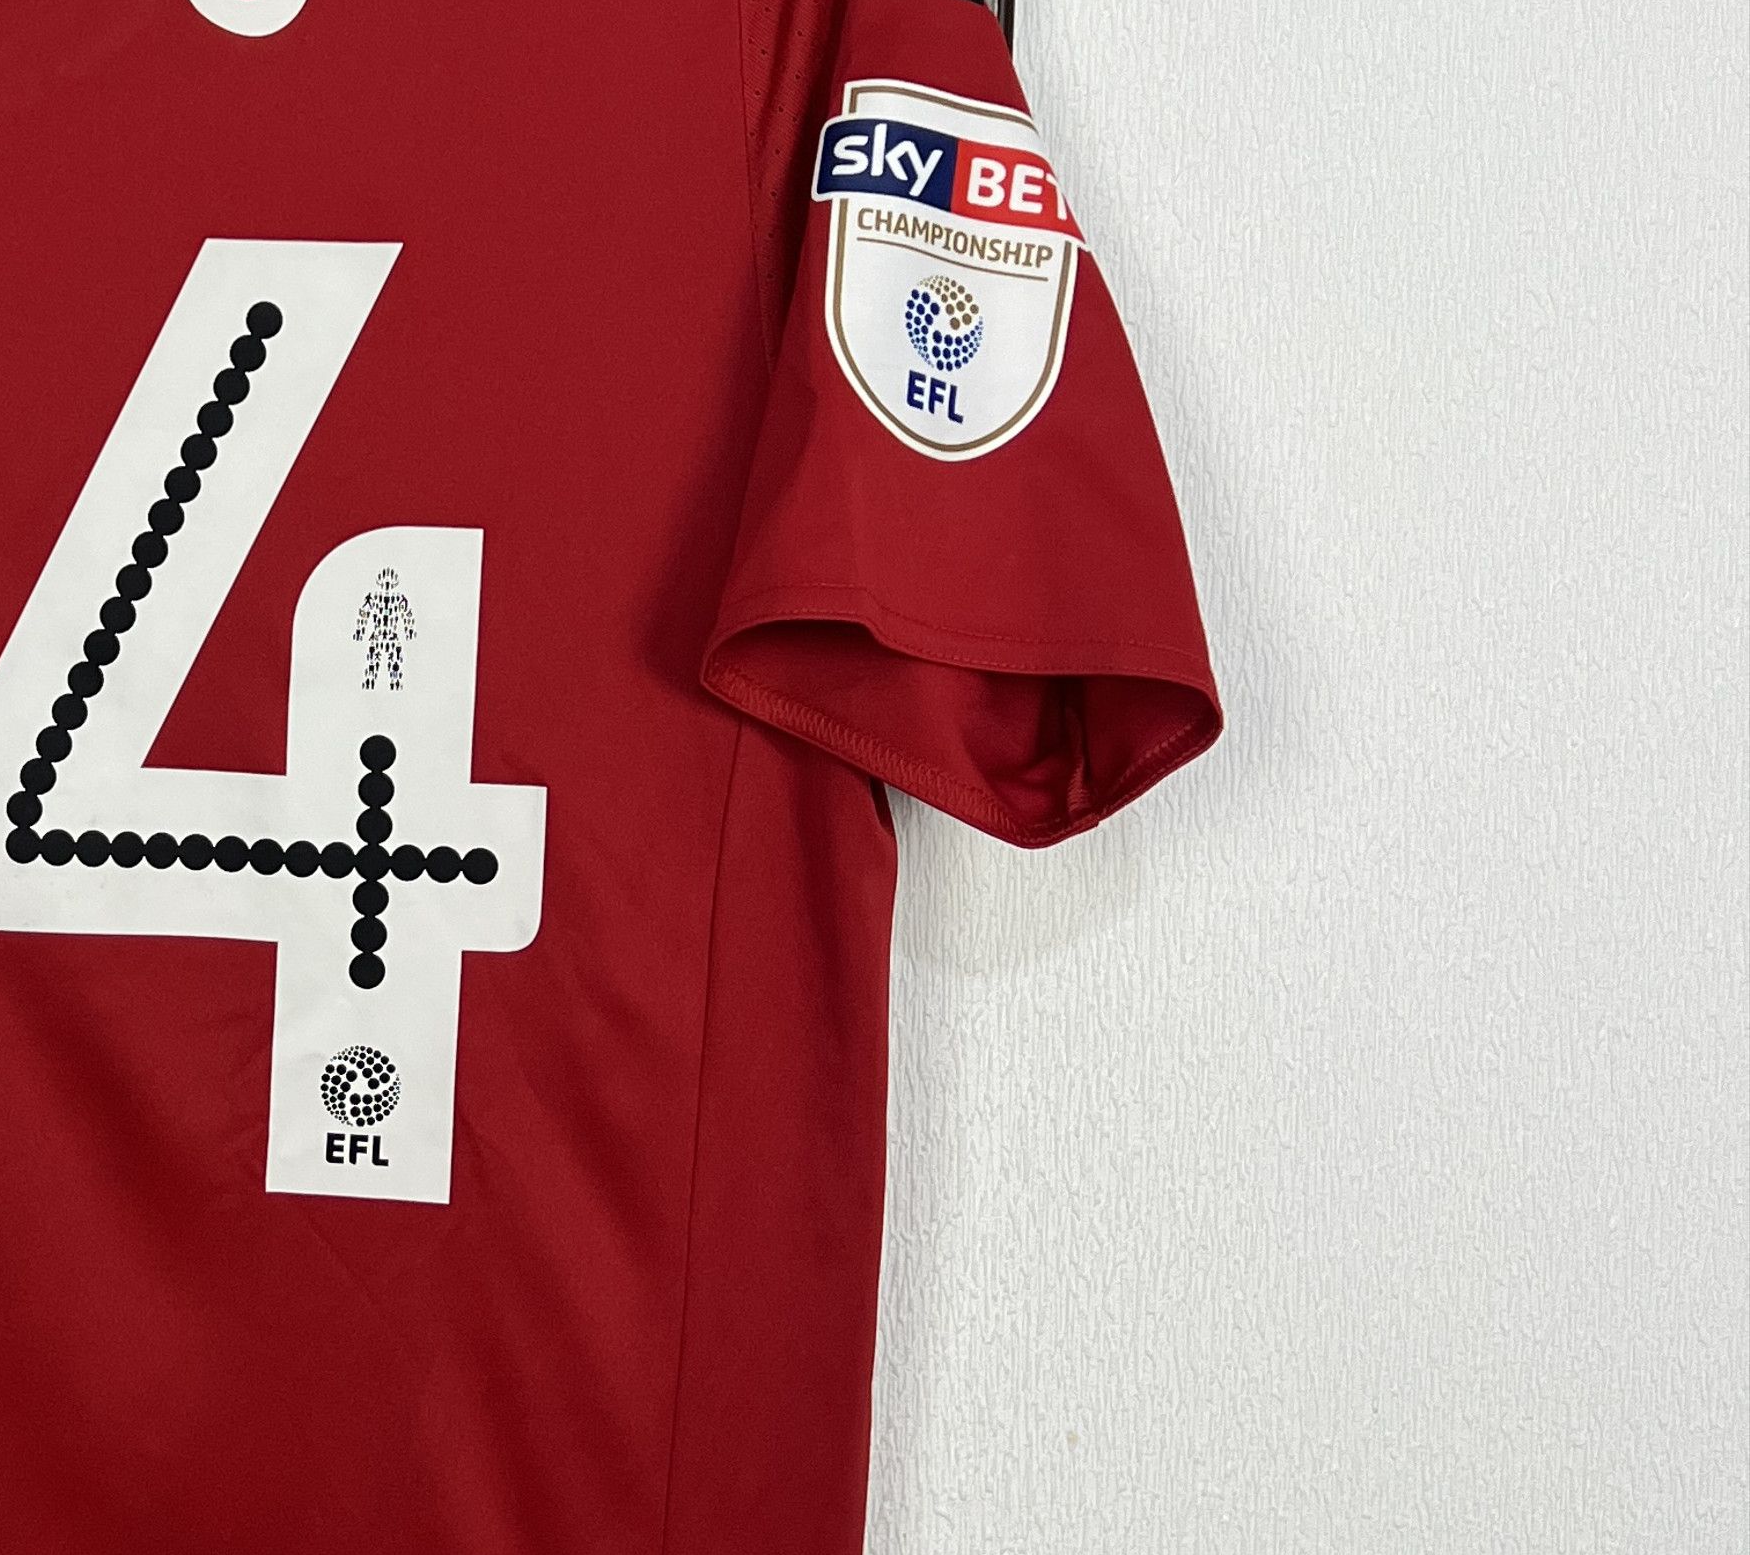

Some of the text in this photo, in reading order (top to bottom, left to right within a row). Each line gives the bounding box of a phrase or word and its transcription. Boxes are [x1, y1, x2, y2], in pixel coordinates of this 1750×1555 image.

[857, 207, 1053, 269] CHAMPIONSHIP
[906, 369, 964, 424] EFL
[325, 1132, 389, 1167] EFL
